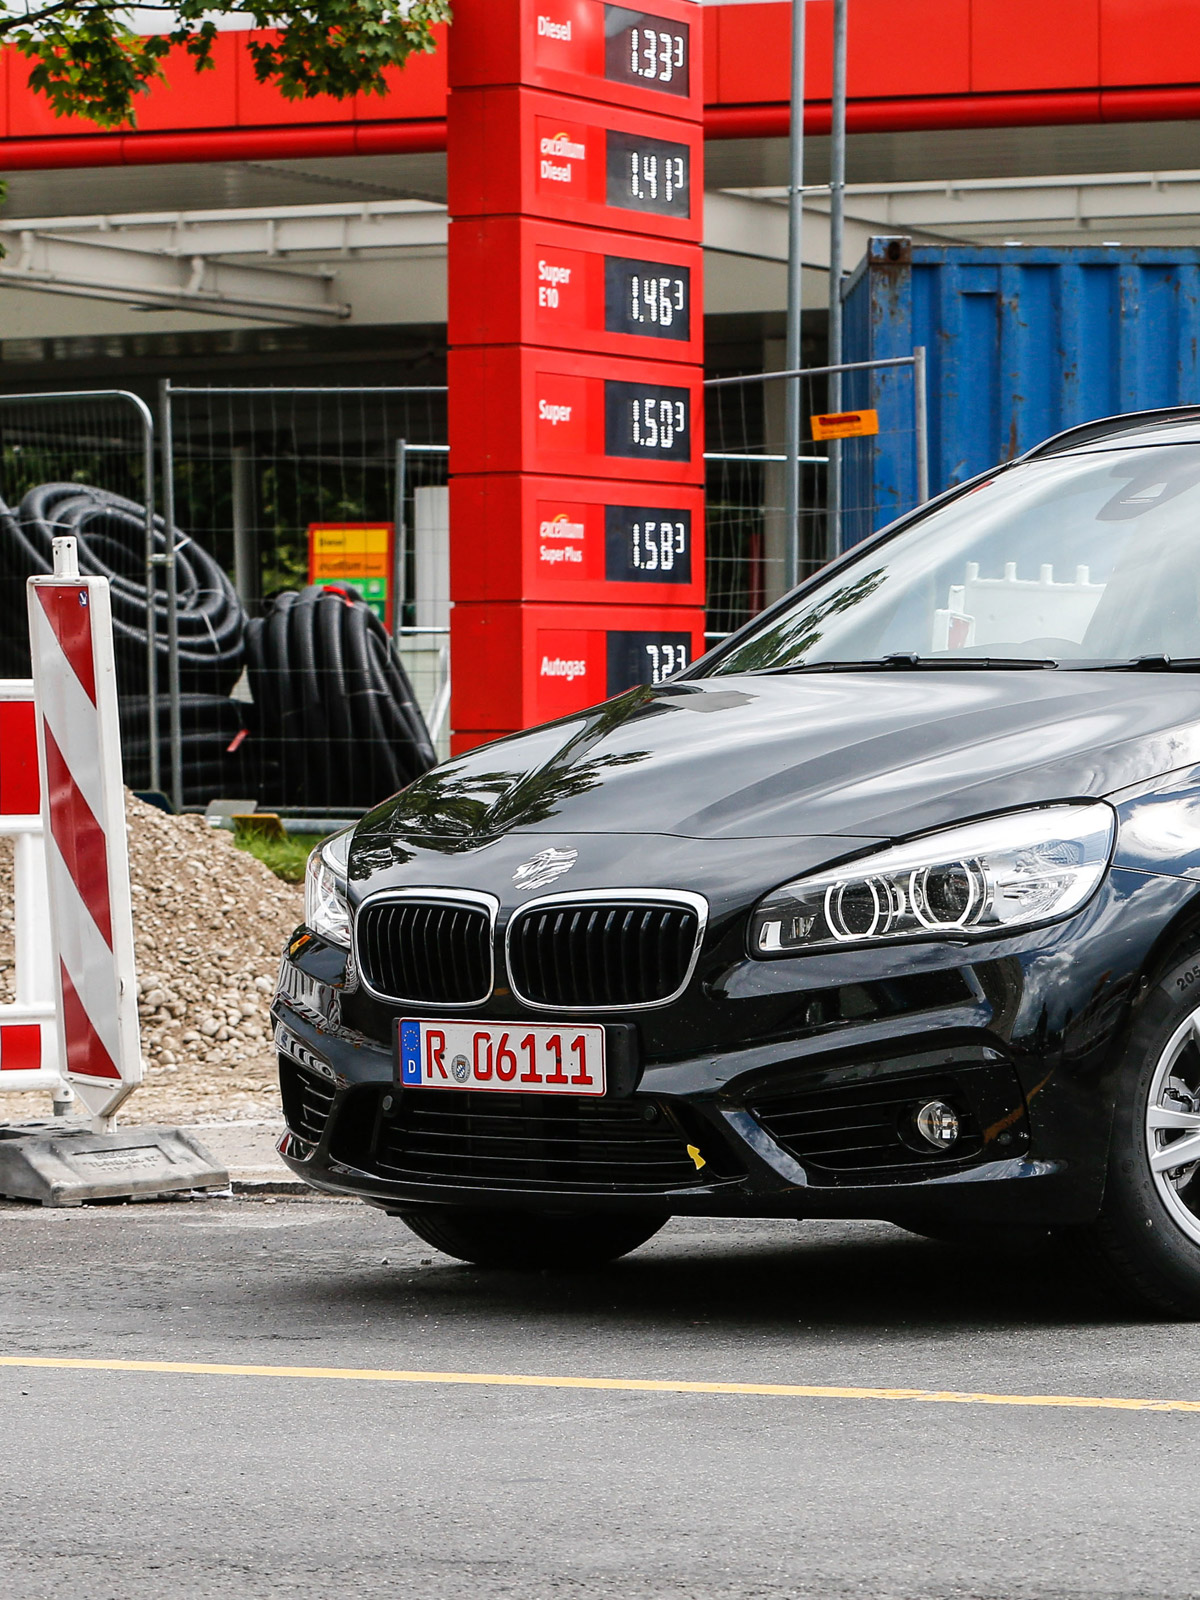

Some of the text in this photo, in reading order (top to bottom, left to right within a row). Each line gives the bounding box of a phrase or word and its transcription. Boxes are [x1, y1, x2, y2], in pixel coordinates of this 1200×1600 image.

[537, 16, 571, 41] Diesel
[540, 135, 585, 160] excellium
[540, 160, 571, 182] Diesel
[538, 260, 571, 286] Super
[538, 287, 559, 308] E10
[538, 399, 572, 425] Super
[540, 516, 585, 539] excellium
[540, 546, 583, 564] Super Plus
[540, 656, 586, 681] Autogas
[408, 1059, 416, 1074] D
[426, 1030, 593, 1085] R 06111
